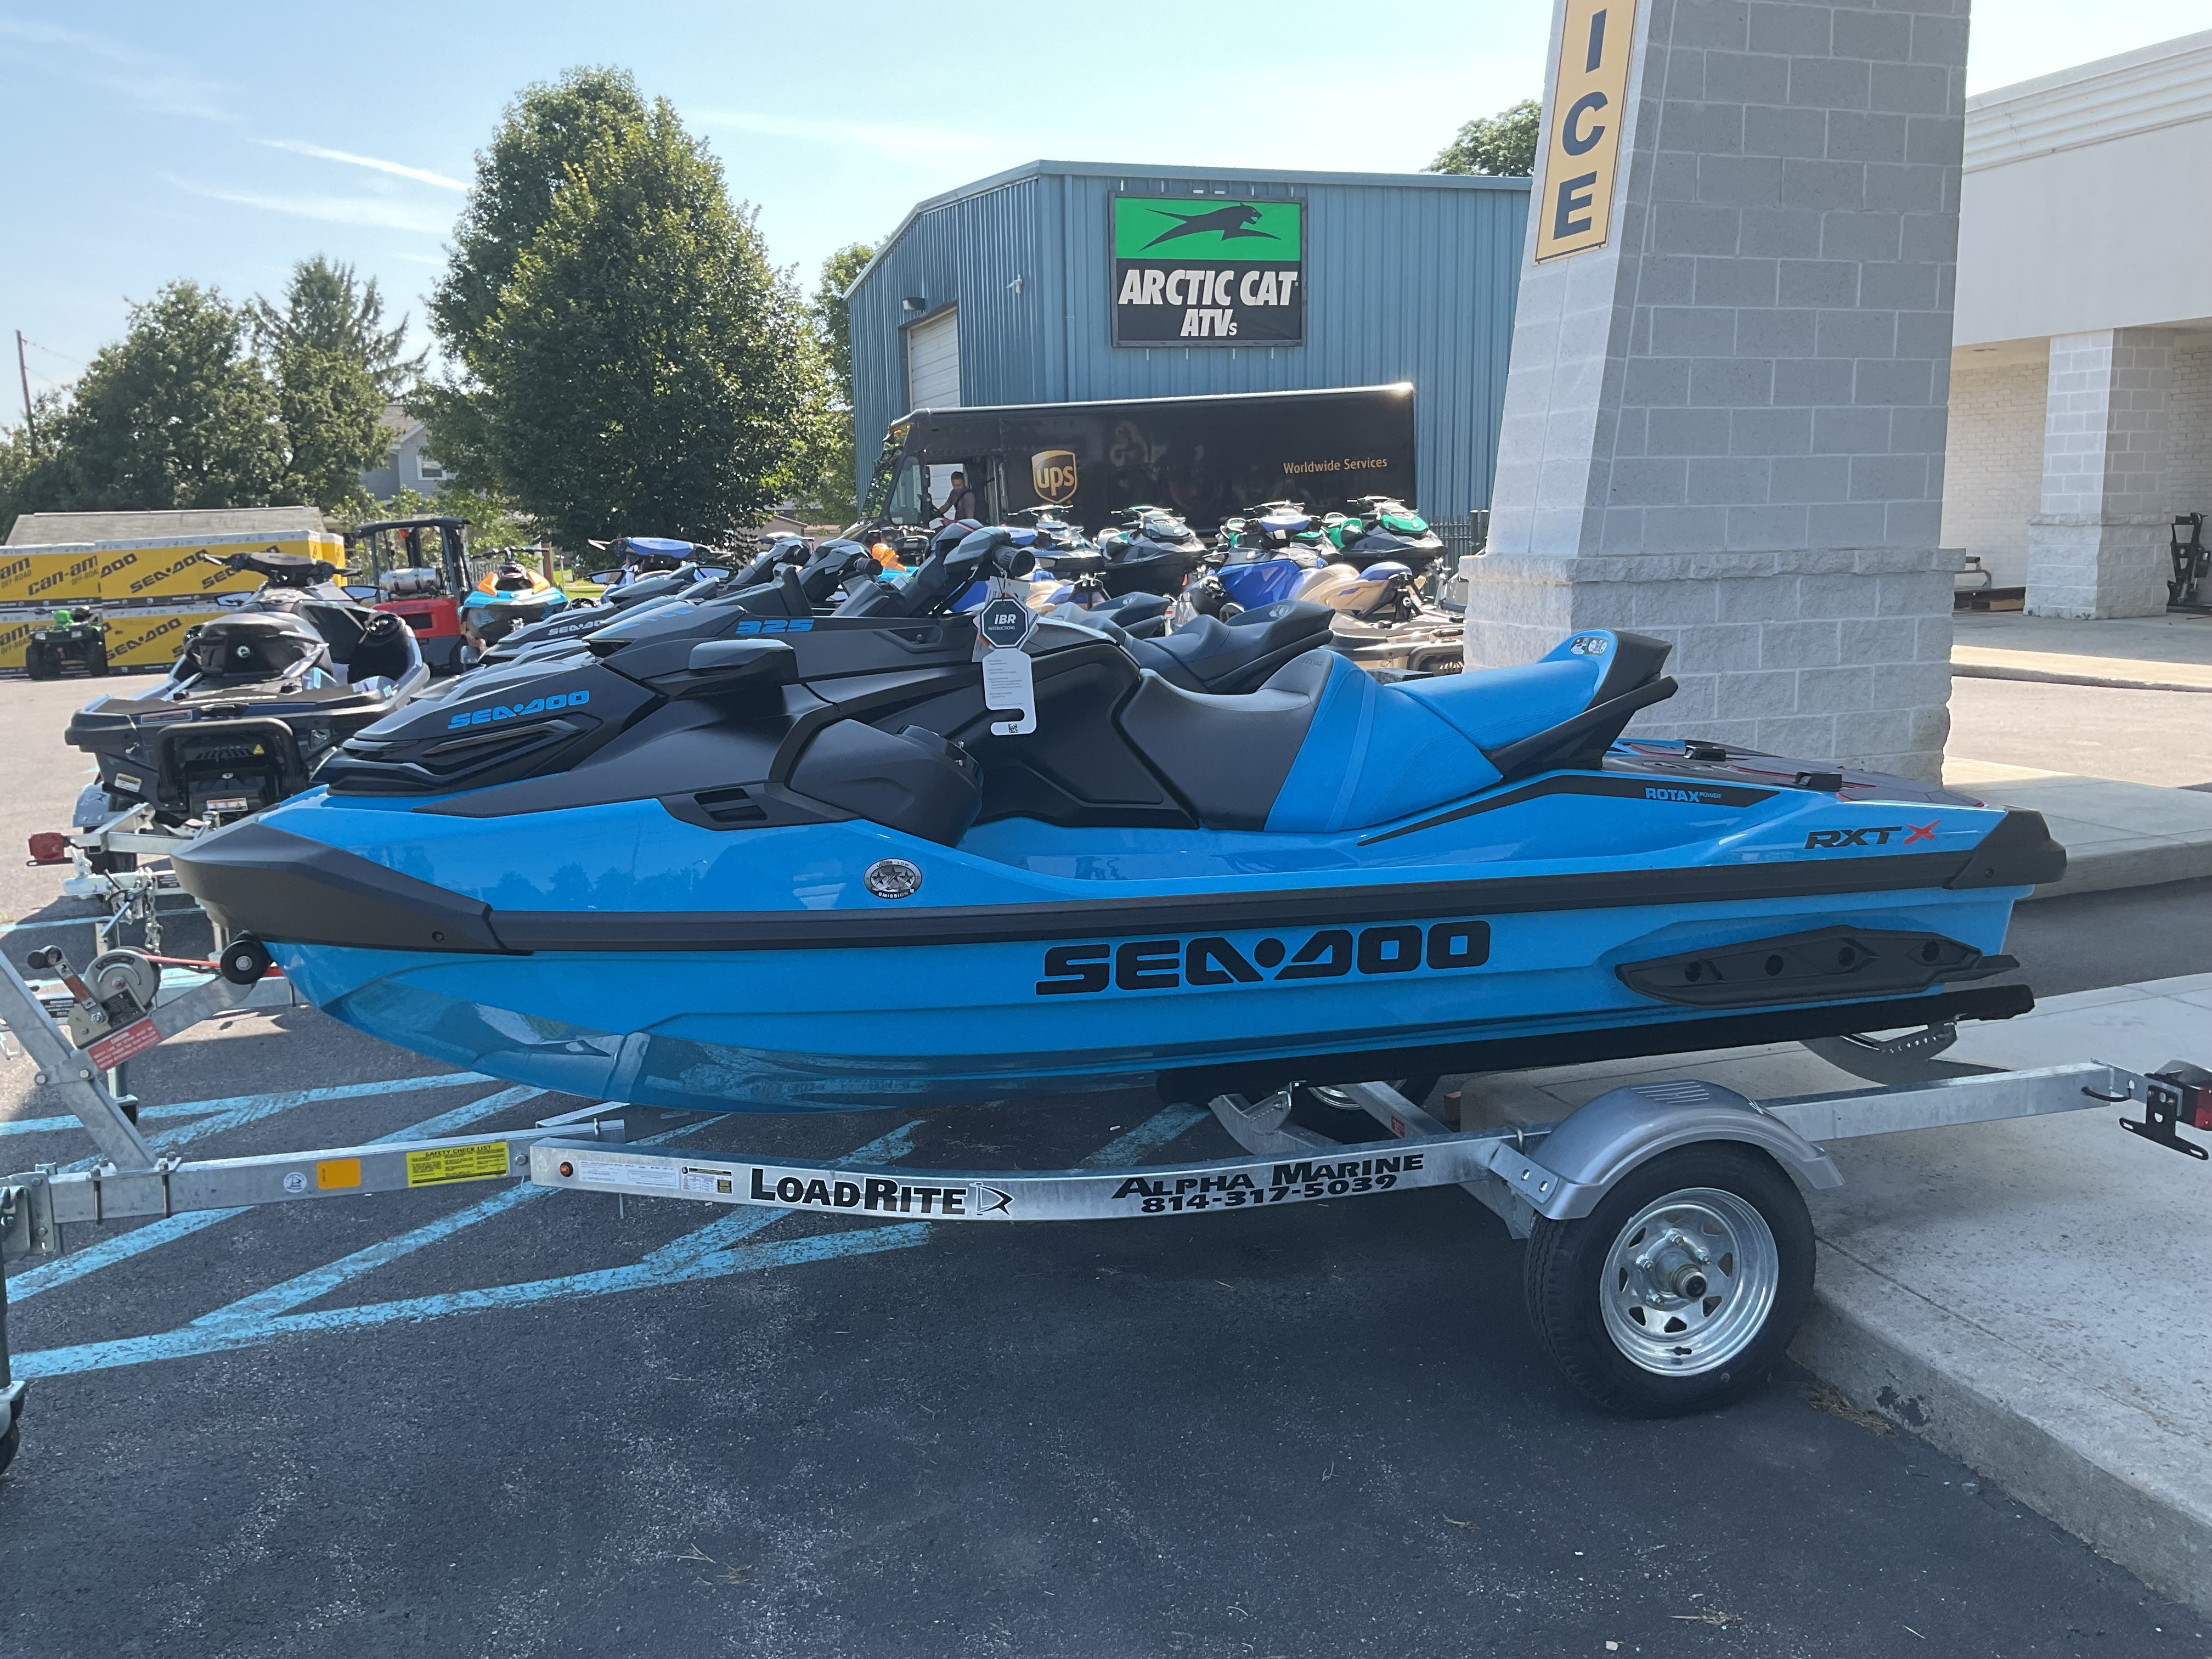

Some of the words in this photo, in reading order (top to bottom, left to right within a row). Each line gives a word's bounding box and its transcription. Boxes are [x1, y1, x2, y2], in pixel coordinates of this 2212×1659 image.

[1118, 269, 1234, 305] ARCTIC
[1240, 272, 1298, 306] CAT
[1283, 460, 1340, 474] Worldwide
[1344, 457, 1387, 470] Services
[1036, 466, 1075, 496] ups
[735, 619, 815, 636] 325
[1645, 787, 1700, 803] ROTAX
[1111, 1177, 1255, 1198] ALPHA
[1272, 1154, 1424, 1186] MARINE
[1141, 1175, 1397, 1213] 814-317-5039
